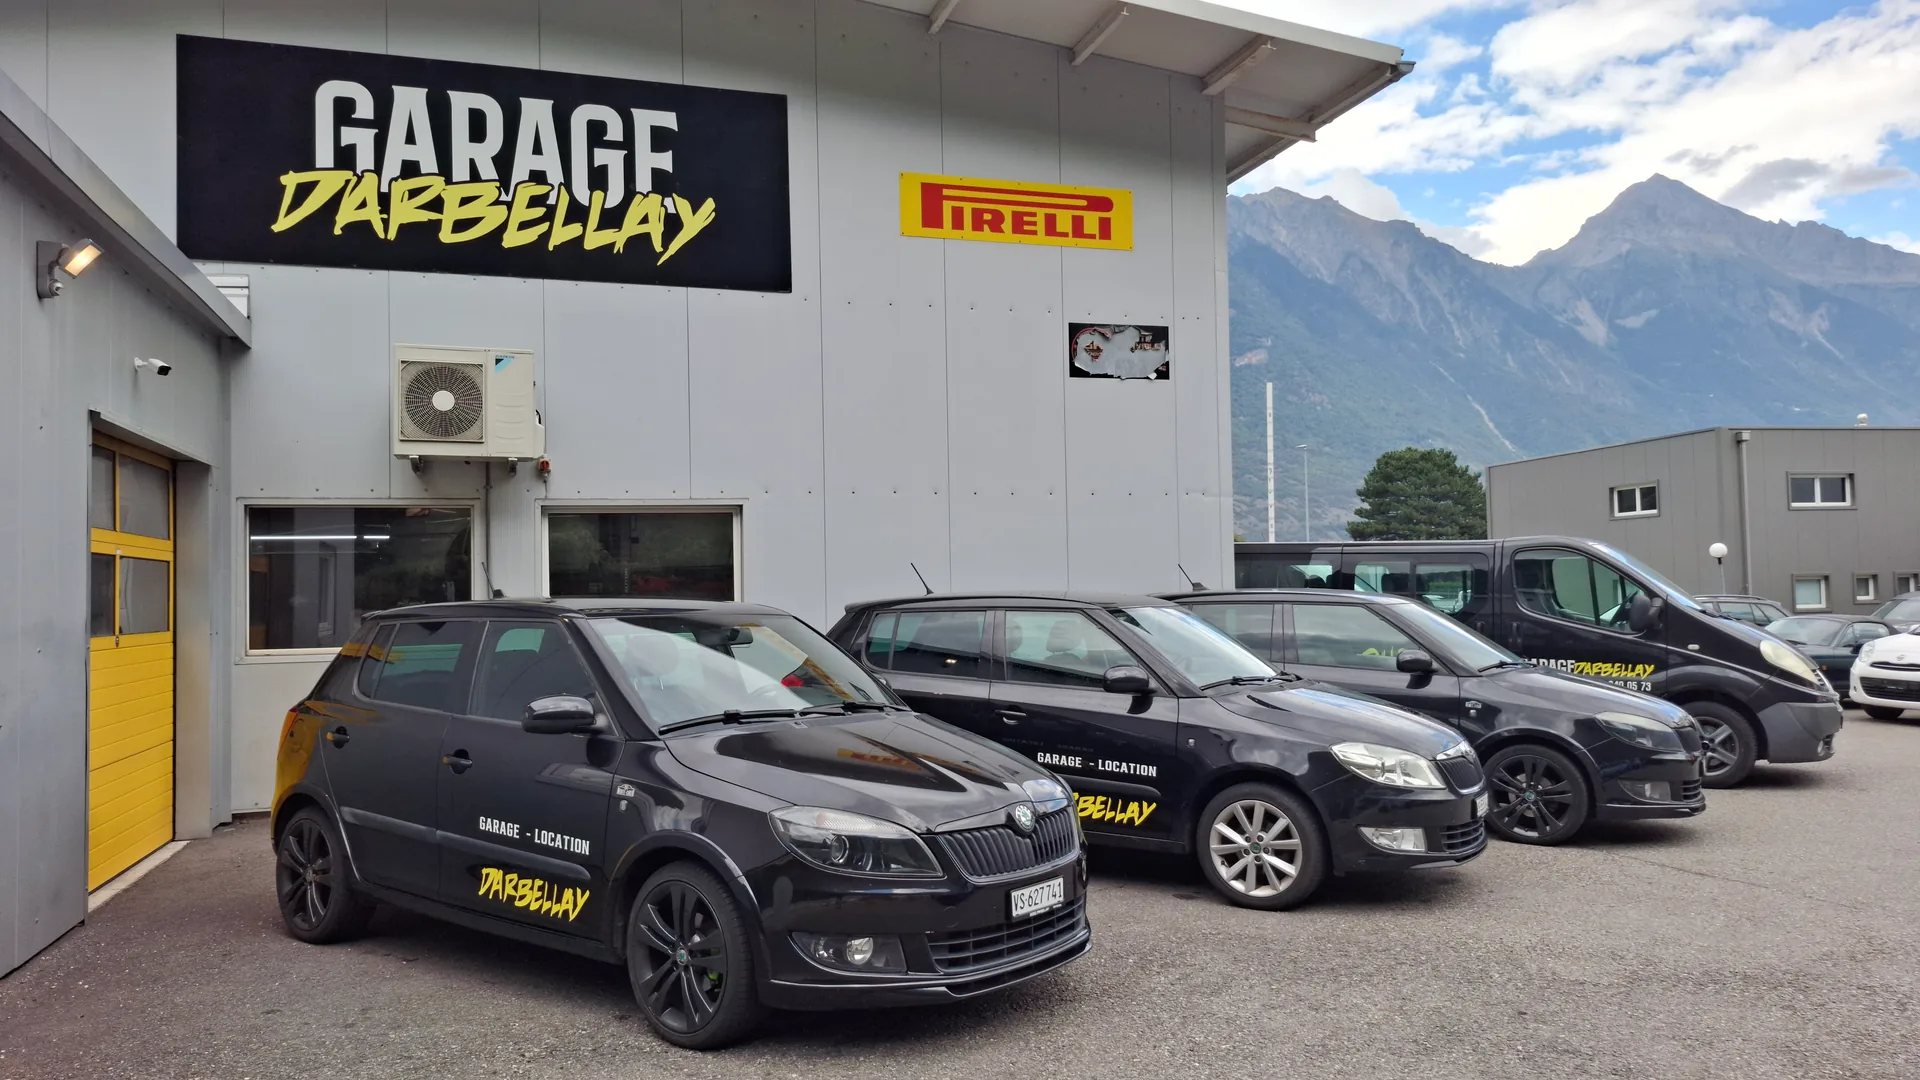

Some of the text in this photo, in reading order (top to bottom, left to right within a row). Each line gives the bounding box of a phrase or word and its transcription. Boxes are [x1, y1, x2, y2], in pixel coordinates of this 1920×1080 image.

[314, 79, 678, 214] GARAGE
[271, 169, 716, 266] DARBELLAY
[920, 181, 1114, 241] PIRELLI
[1574, 661, 1655, 679] DARBELLAY
[1627, 681, 1638, 691] 05
[1640, 682, 1652, 691] 73
[1037, 752, 1082, 768] GARAGE
[1098, 759, 1157, 777] LOCATION
[1073, 792, 1157, 826] BELLAY
[479, 816, 520, 839] GARAGE
[534, 828, 590, 855] LOCATION
[478, 867, 590, 922] DARBELLAY
